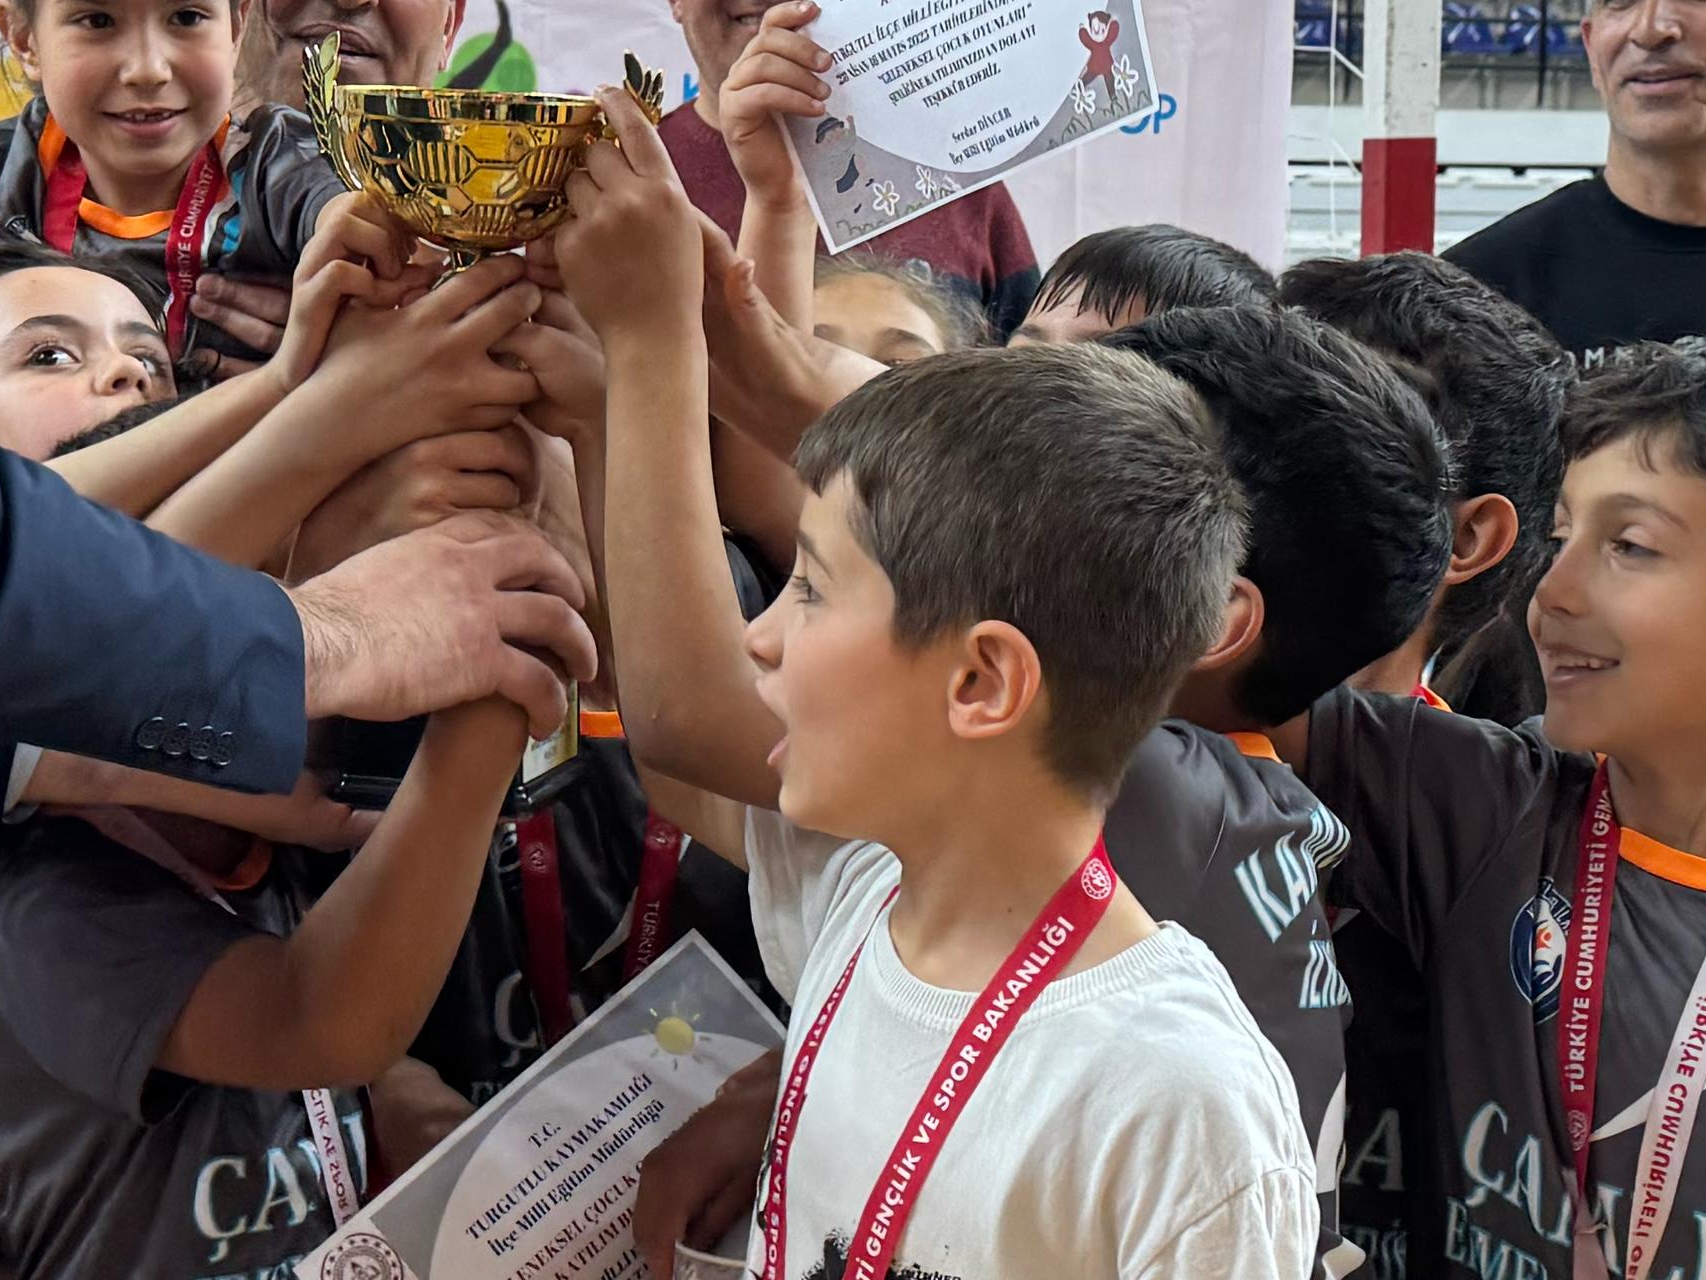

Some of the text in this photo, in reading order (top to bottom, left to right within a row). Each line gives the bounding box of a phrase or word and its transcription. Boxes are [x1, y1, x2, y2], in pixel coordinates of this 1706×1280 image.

[1574, 843, 1609, 992] CUMHURİYETİ
[865, 1147, 923, 1258] GENÇLİK
[911, 1112, 941, 1146] VE
[931, 1043, 983, 1111] SPOR
[975, 914, 1077, 1045] BAKANLIĞI
[1565, 995, 1591, 1095] TÜRKİYE
[464, 1071, 655, 1241] TURGUTLU KAYMAKAMLIĞI
[488, 1098, 666, 1258] İlçe Milli Eğitim Müdürlüğü
[527, 1121, 563, 1151] T.C.
